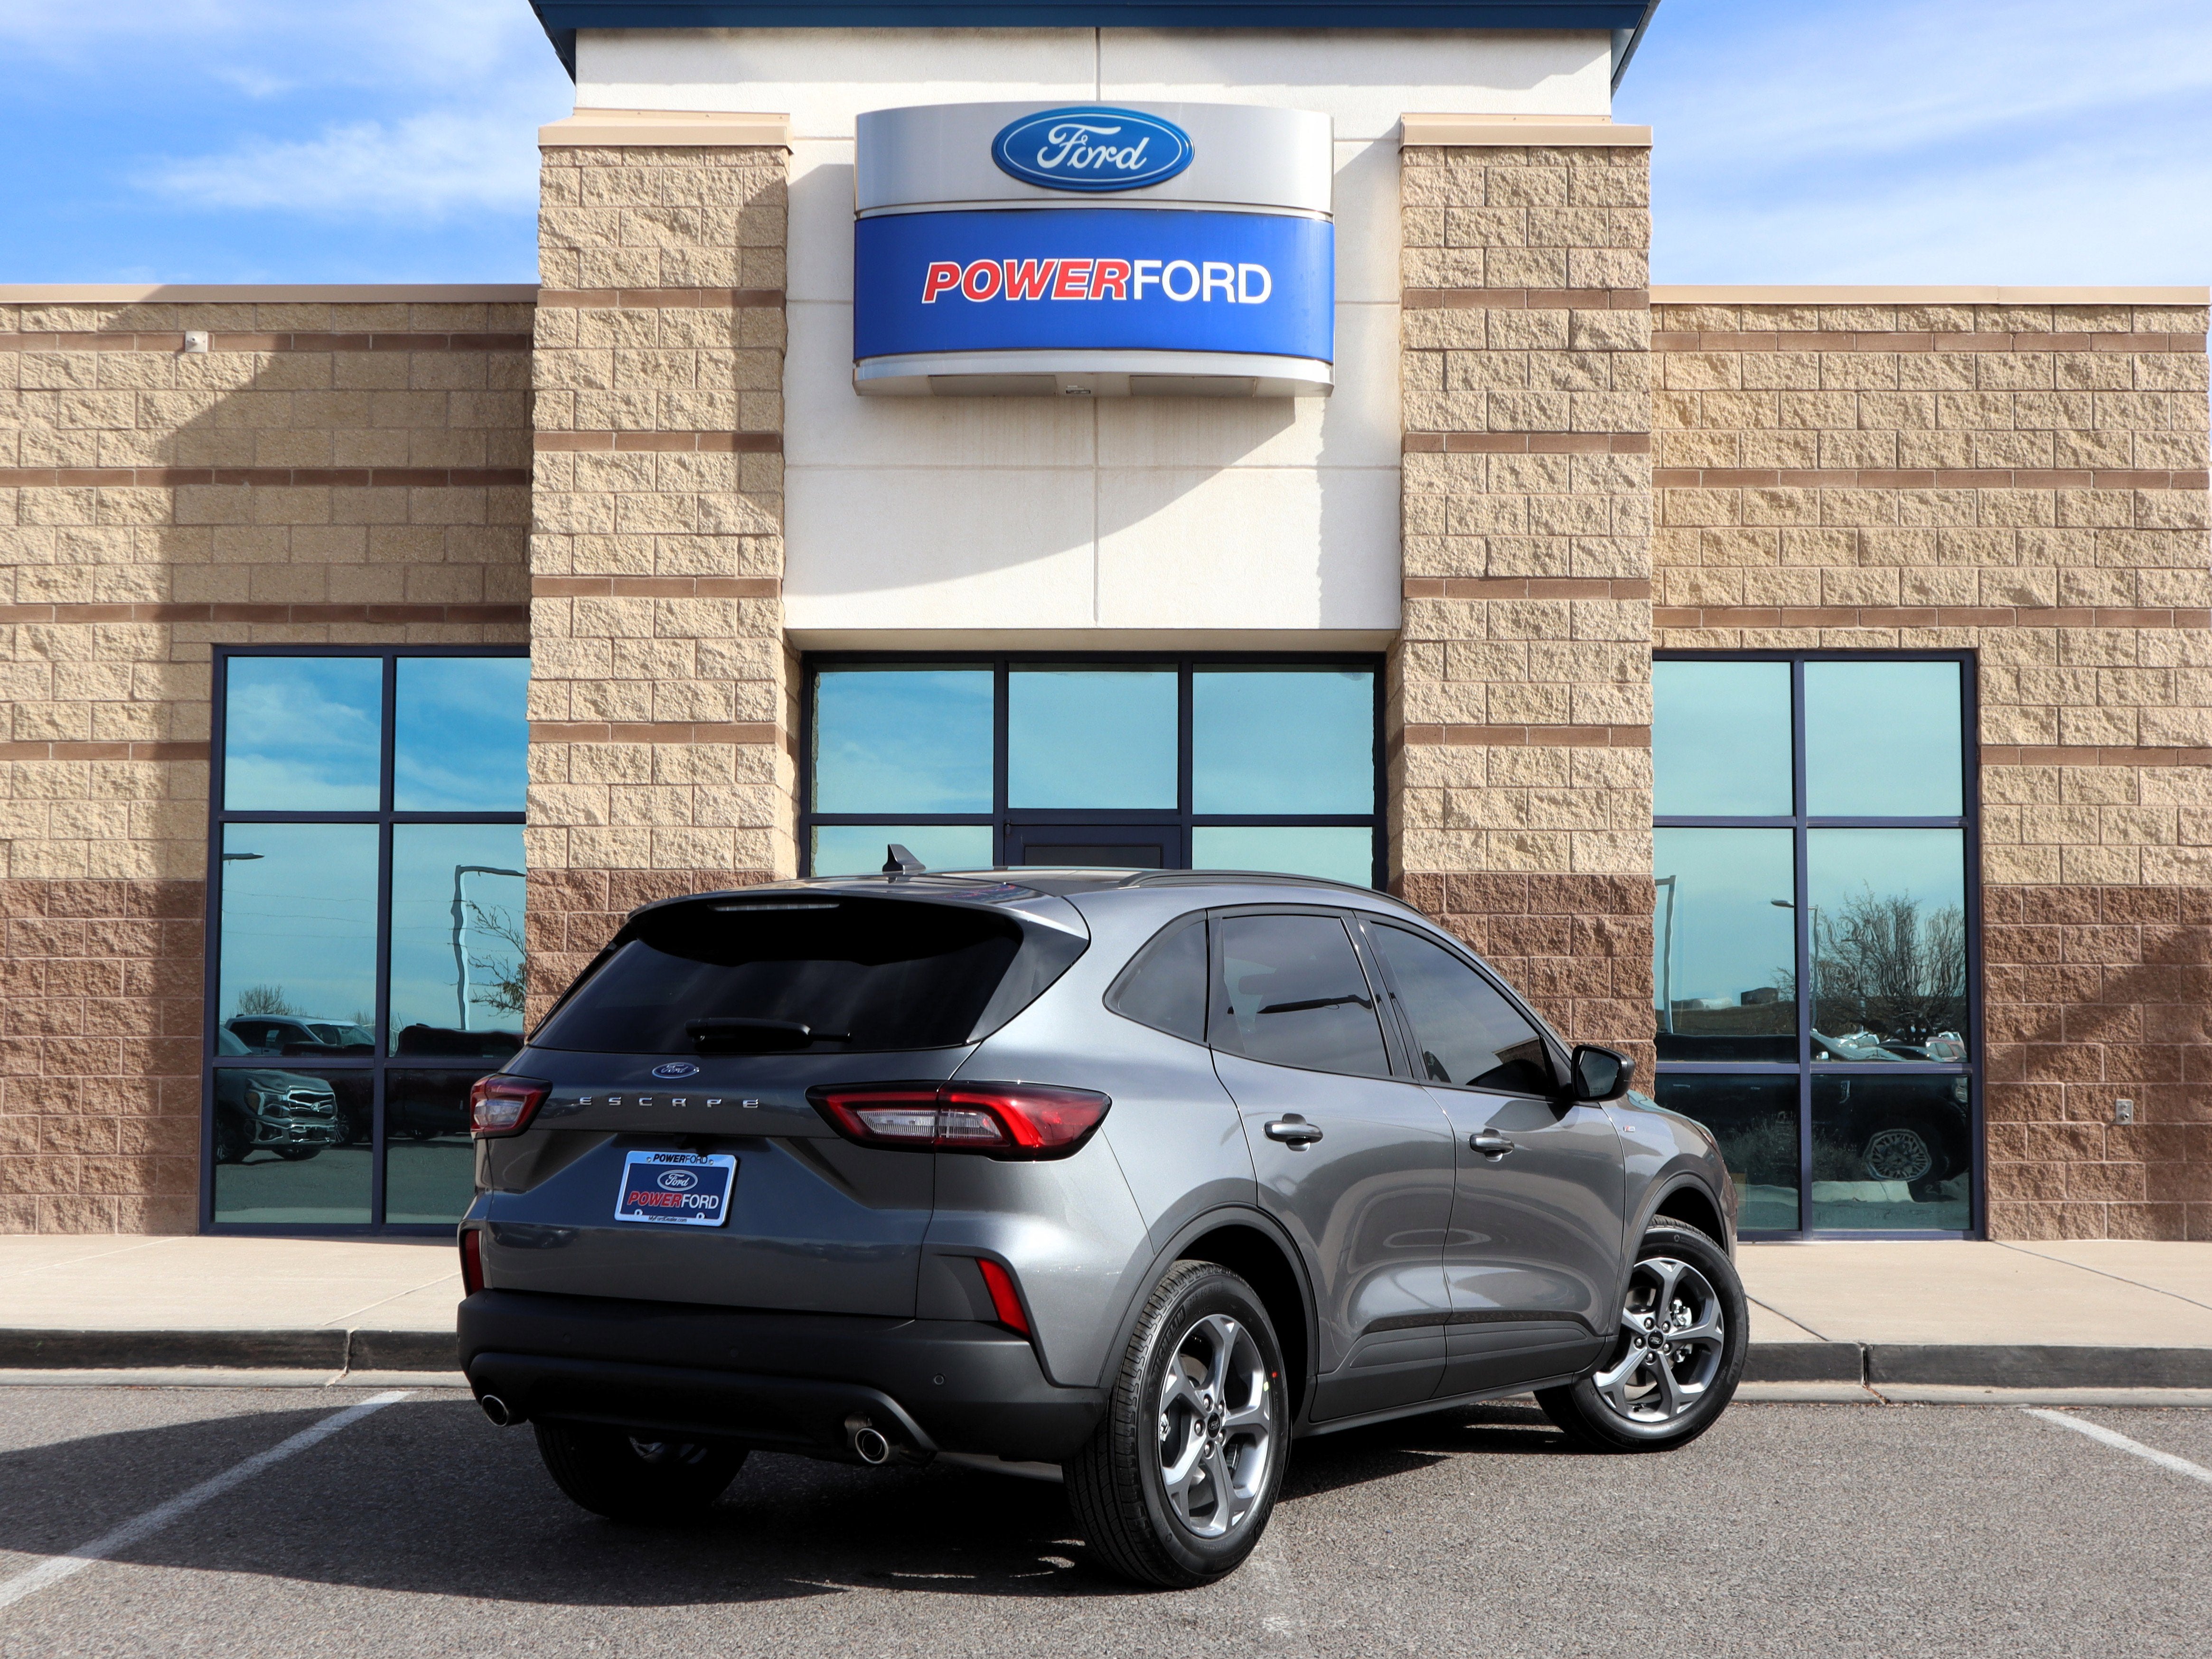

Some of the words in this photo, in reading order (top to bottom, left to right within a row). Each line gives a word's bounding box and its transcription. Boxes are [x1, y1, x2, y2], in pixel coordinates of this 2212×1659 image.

[1037, 123, 1150, 170] Ford
[921, 258, 1272, 304] POWERFORD
[580, 1096, 759, 1109] ESCAPE
[653, 1153, 708, 1164] POWERFORD
[665, 1173, 690, 1187] Ford
[627, 1190, 719, 1209] POWERFORD
